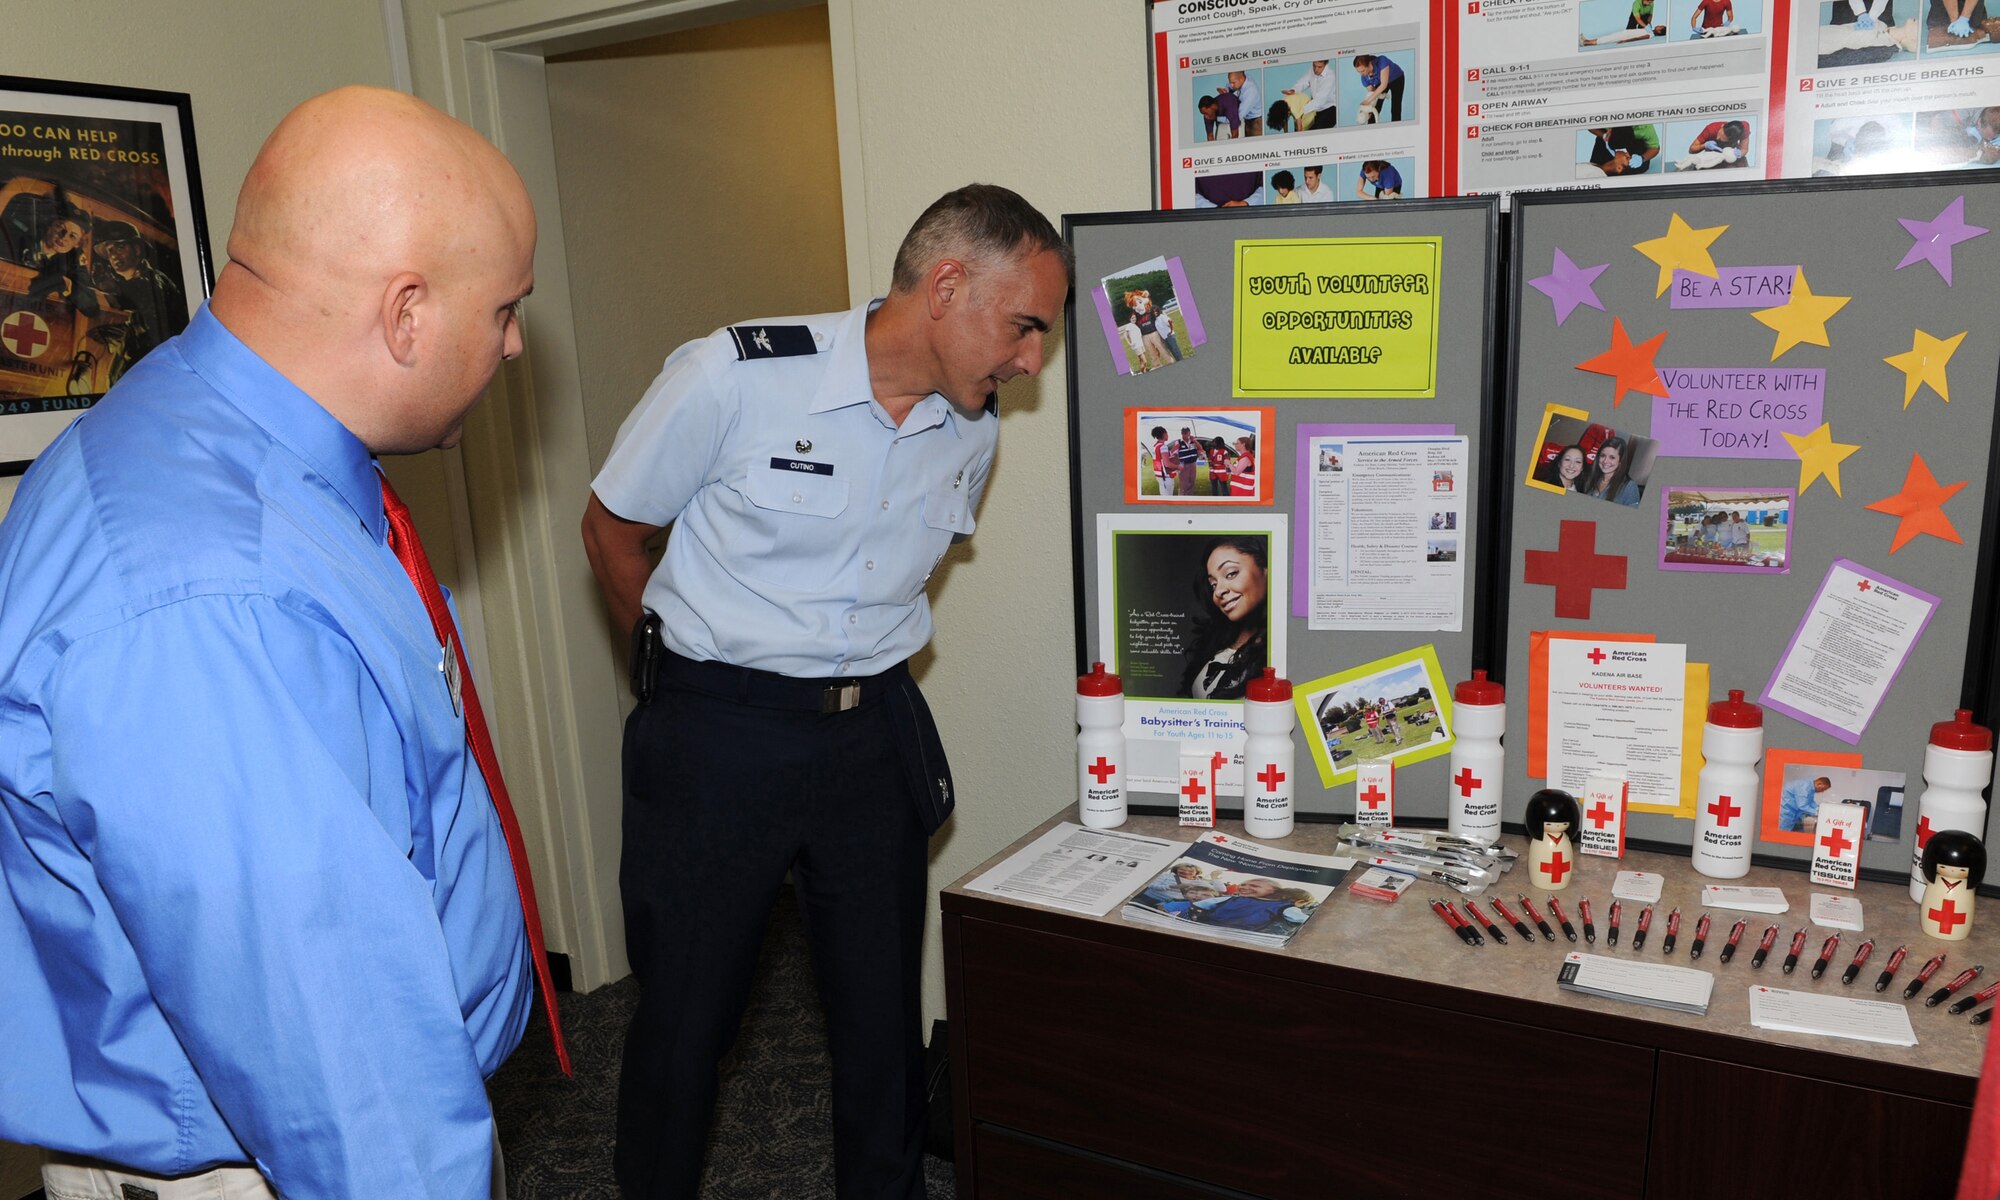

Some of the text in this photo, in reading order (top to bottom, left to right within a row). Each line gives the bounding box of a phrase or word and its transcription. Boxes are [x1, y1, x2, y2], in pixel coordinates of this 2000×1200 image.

[1178, 14, 1210, 24] Cannot
[1213, 8, 1246, 18] Cough,
[1248, 3, 1281, 14] Speak,
[1284, 0, 1300, 8] Cry
[1191, 56, 1213, 66] GIVE
[1223, 51, 1249, 62] BACK
[1252, 46, 1287, 58] BLOWS
[1469, 64, 1530, 80] 2 CALL 9-1-1
[1801, 66, 1984, 90] 2 GIVE 2 RESCUE BREATHS
[1469, 105, 1477, 115] 3
[1482, 102, 1508, 110] OPEN
[1511, 98, 1548, 107] AIRWAY
[1469, 127, 1477, 137] 4
[1482, 124, 1513, 132] CHECK
[1535, 117, 1587, 128] BREATHING
[1589, 115, 1609, 123] FOR
[1627, 111, 1654, 119] MORE
[1657, 108, 1683, 116] THAN
[1698, 102, 1747, 113] SECONDS
[33, 127, 70, 140] CAN
[77, 129, 118, 143] HELP
[2, 144, 159, 165] through RED CROSS
[1194, 157, 1215, 166] GIVE
[1225, 151, 1281, 163] ABDOMINAL
[1284, 146, 1328, 157] THRUSTS
[1680, 275, 1793, 298] BE A STAR!
[1662, 369, 1818, 392] VOLUNTEER WITH
[42, 398, 91, 410] FUND
[1667, 399, 1808, 420] THE RED CROSS
[1700, 428, 1769, 449] TODAY!
[790, 461, 815, 472] CUTINO
[1877, 586, 1899, 597] American
[1884, 593, 1897, 601] Cross
[1579, 682, 1663, 693] VOLUNTEERS WANTED!
[1159, 707, 1191, 715] American
[1204, 719, 1246, 731] Training
[1187, 731, 1205, 740] Ages
[1596, 792, 1606, 800] Gift
[1832, 818, 1845, 827] Gift
[1846, 820, 1853, 828] of
[1582, 834, 1595, 842] Red
[1583, 829, 1615, 838] American
[1705, 830, 1742, 840] American
[1581, 842, 1617, 851] TISSUES
[1704, 836, 1742, 846] Red Cross
[1211, 848, 1236, 859] Coming
[1237, 855, 1258, 864] Home
[1258, 860, 1276, 868] From
[1816, 856, 1852, 867] American
[1815, 862, 1852, 873] Red Cross
[1812, 870, 1854, 882] TISSUES
